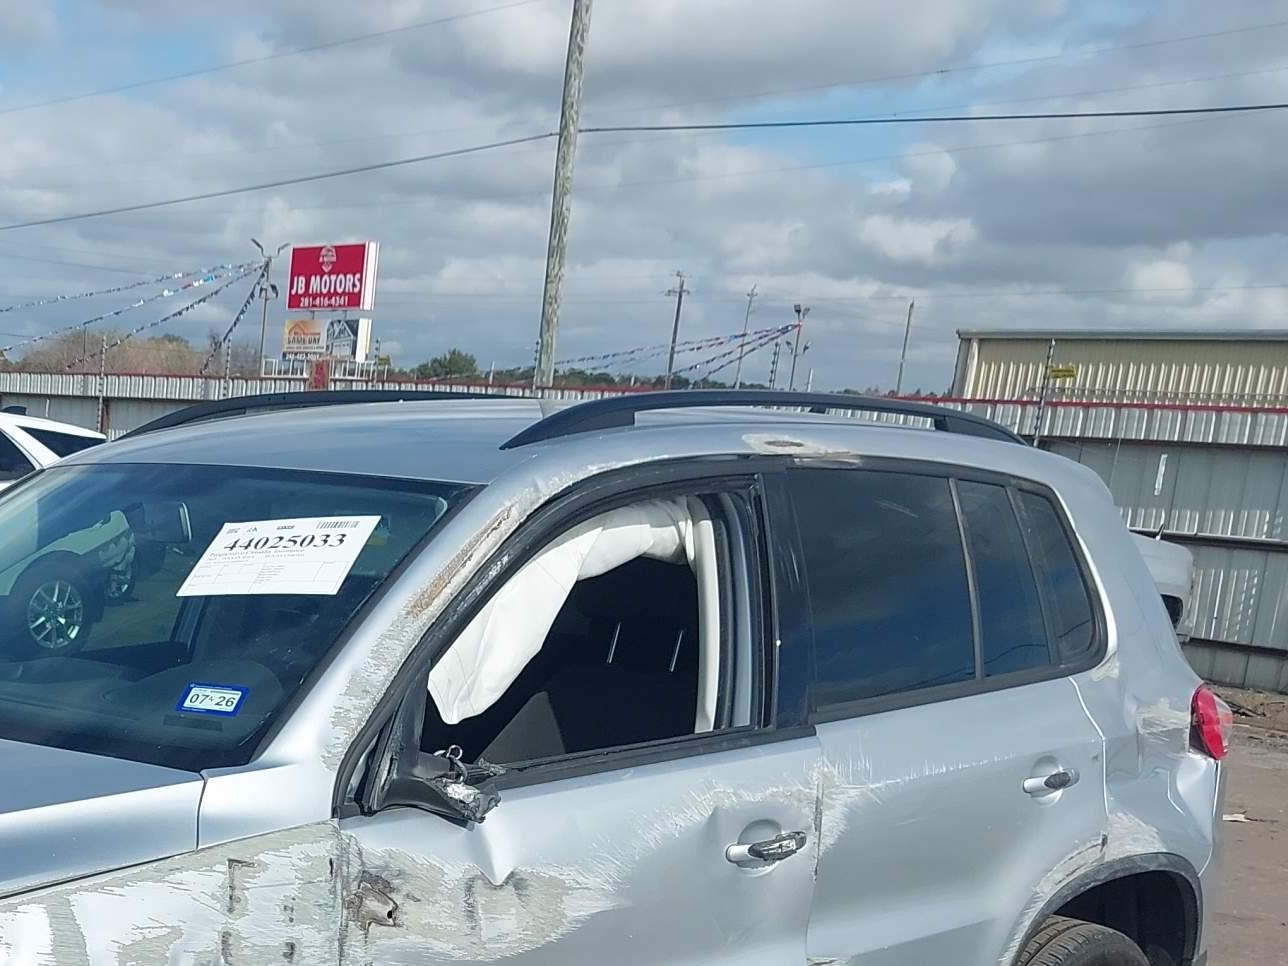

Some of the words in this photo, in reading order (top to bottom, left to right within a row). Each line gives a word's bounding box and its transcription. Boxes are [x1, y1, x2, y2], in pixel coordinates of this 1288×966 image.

[291, 275, 306, 295] JB
[309, 273, 361, 294] MOTORS
[224, 533, 347, 552] 44025033
[189, 693, 210, 705] 07
[214, 695, 236, 708] 26
